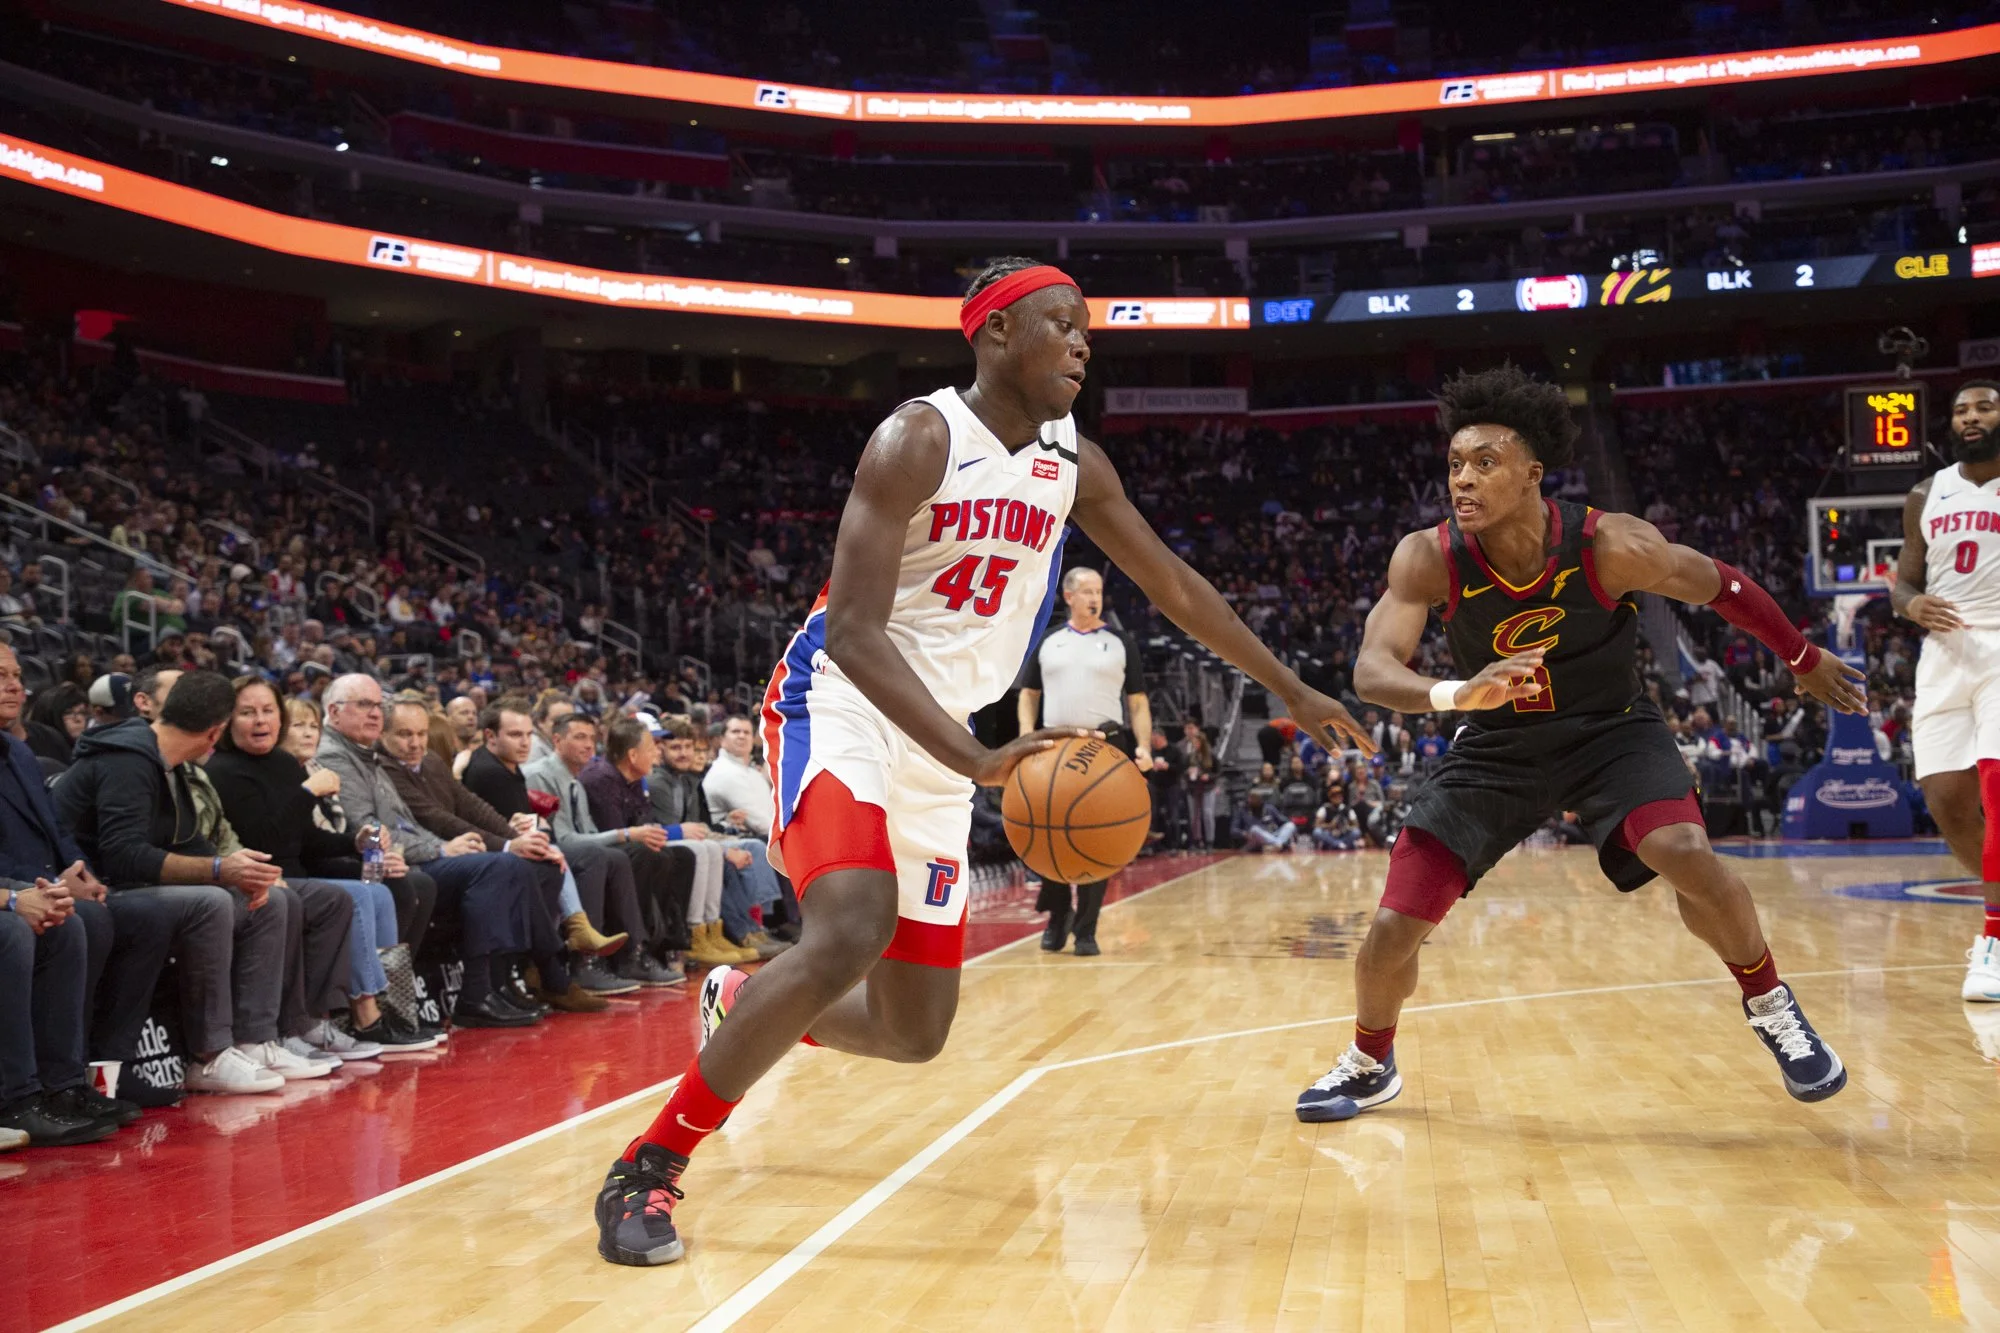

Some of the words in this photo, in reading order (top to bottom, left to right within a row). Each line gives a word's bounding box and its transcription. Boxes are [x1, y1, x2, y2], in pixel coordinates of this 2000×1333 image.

[1706, 269, 1753, 291] BLK
[1795, 264, 1814, 287] 2
[1895, 254, 1949, 279] CLE
[1263, 298, 1315, 324] DET
[1367, 294, 1411, 315] BLK
[1456, 289, 1475, 311] 2
[1867, 392, 1915, 414] 4:24
[1876, 413, 1909, 447] 16
[928, 498, 1057, 553] PISTONS
[1954, 540, 1980, 575] 0
[931, 554, 1020, 618] 45
